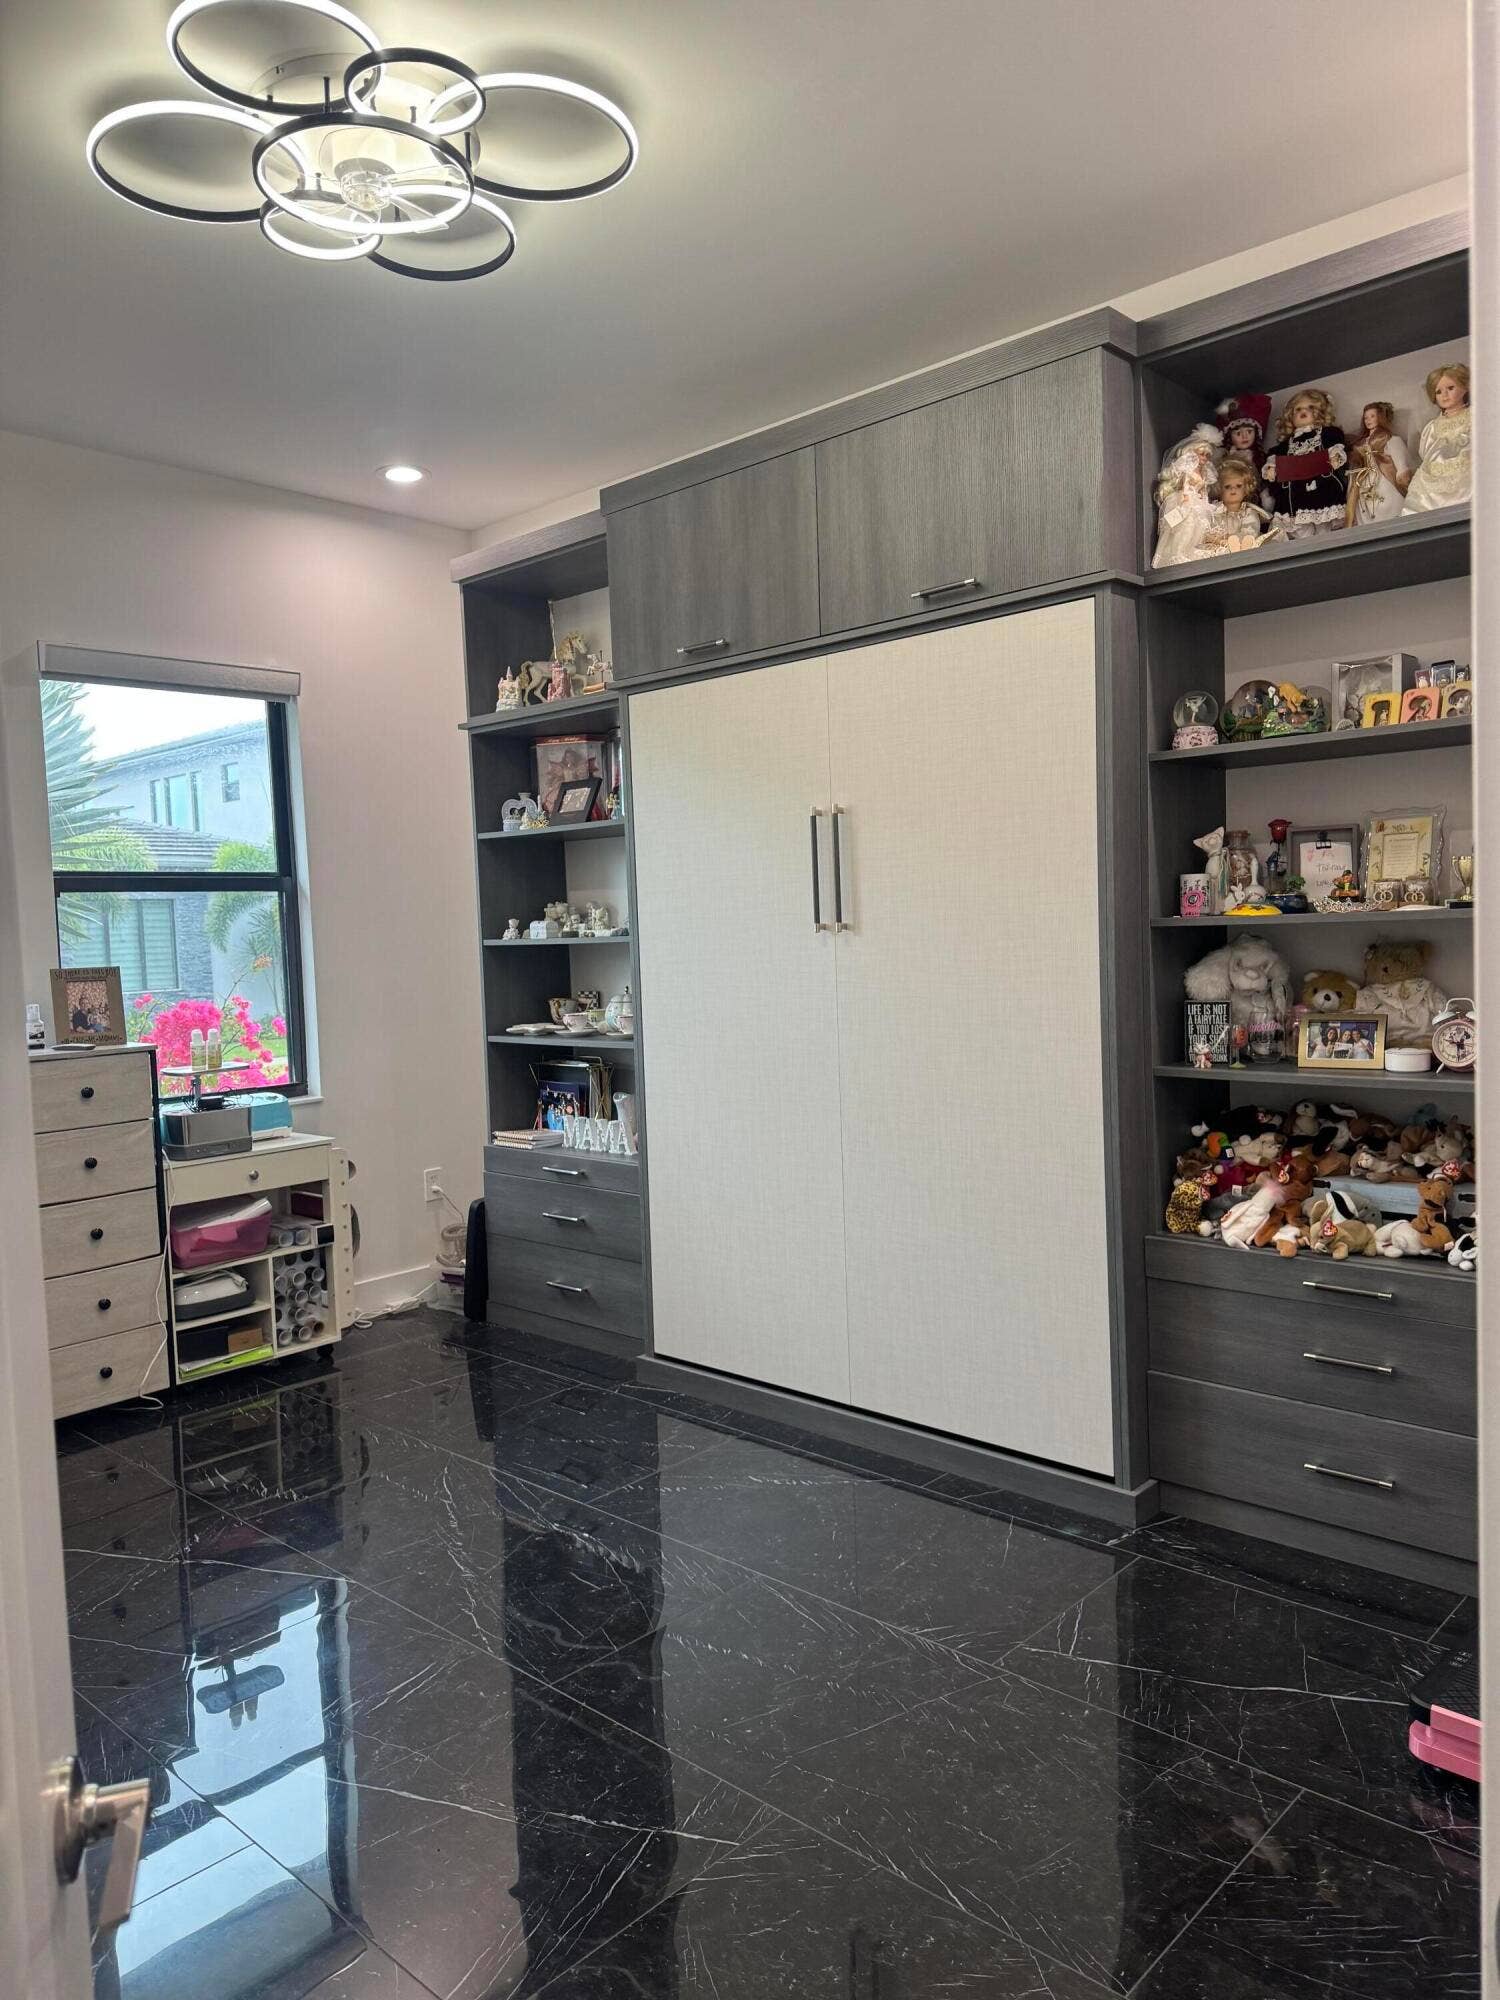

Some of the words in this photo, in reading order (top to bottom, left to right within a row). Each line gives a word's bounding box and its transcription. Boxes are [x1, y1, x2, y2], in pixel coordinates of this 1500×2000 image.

[1188, 1004, 1201, 1015] LIFE
[1204, 1004, 1211, 1015] IS
[1212, 1004, 1227, 1015] NOT
[1188, 1014, 1193, 1025] A
[1194, 1014, 1228, 1025] FAIRYTALE
[1189, 1024, 1194, 1035] IF
[1196, 1024, 1210, 1035] YOU
[561, 1115, 633, 1155] MAMA
